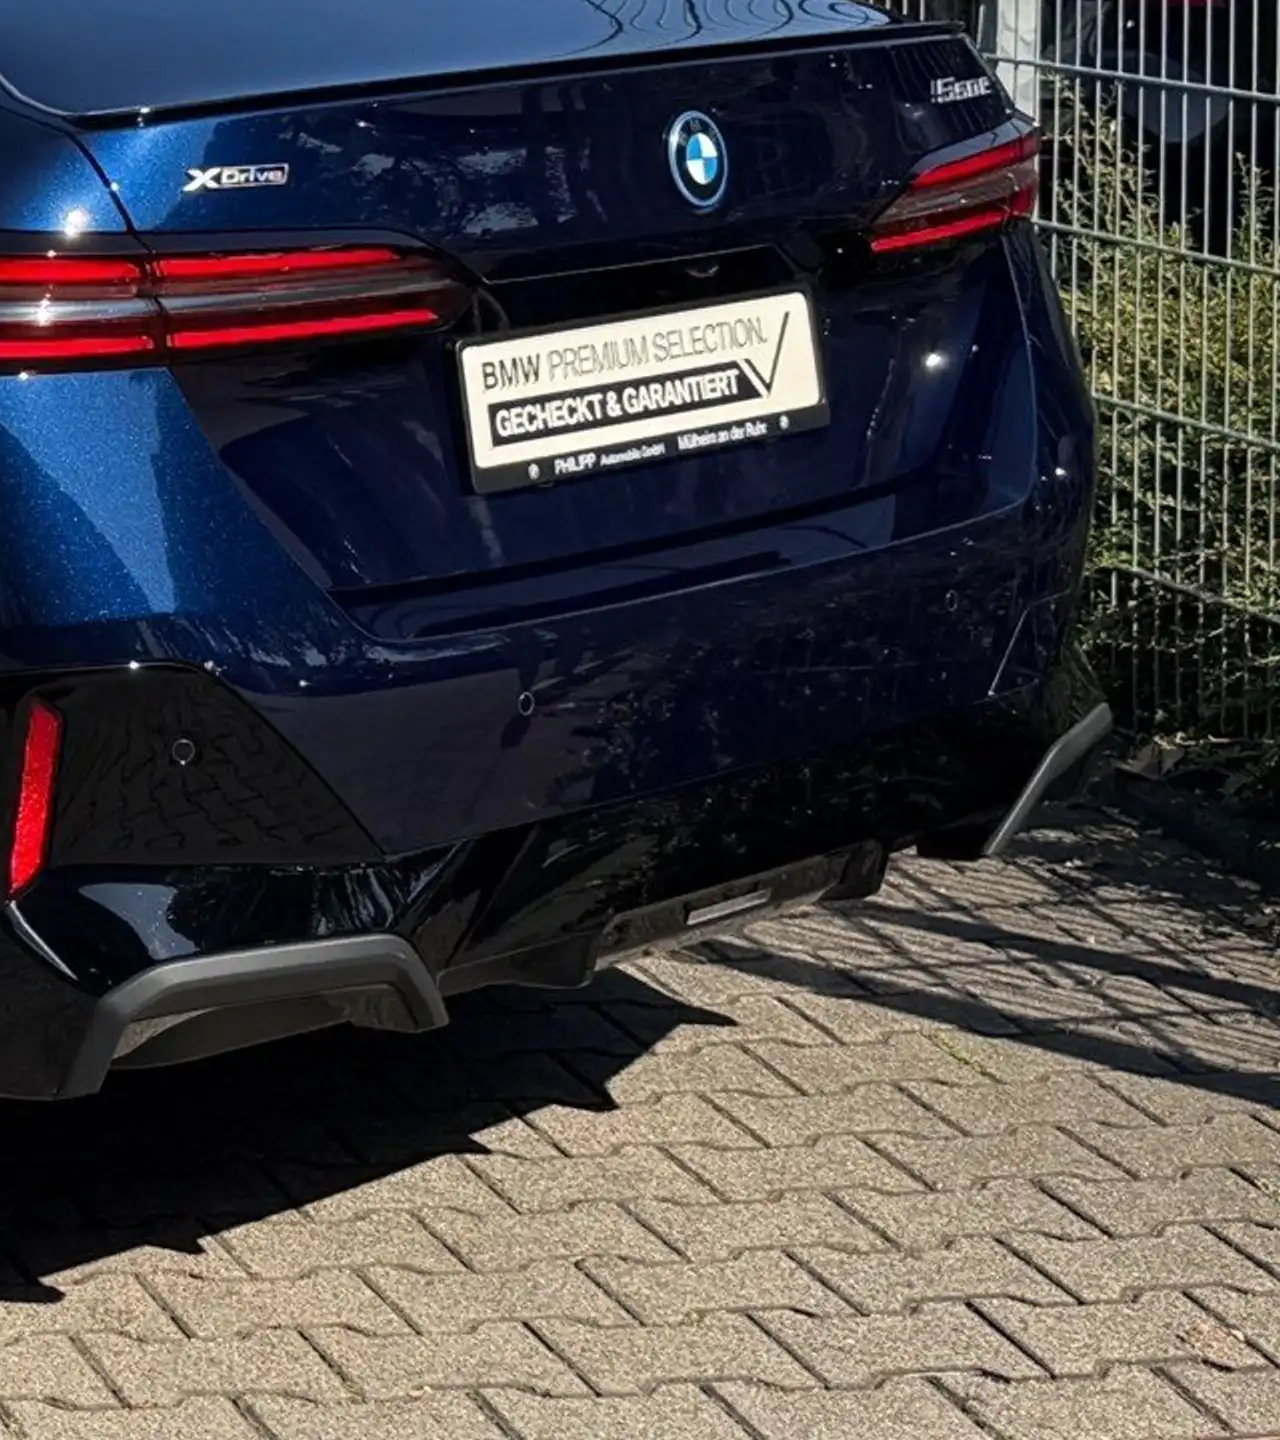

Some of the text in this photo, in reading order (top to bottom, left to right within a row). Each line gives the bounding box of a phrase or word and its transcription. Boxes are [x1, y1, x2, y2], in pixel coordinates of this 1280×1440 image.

[481, 316, 768, 393] BMW PREMIUM SELECTION.
[495, 368, 740, 438] GECHECKT & GARANTIERT
